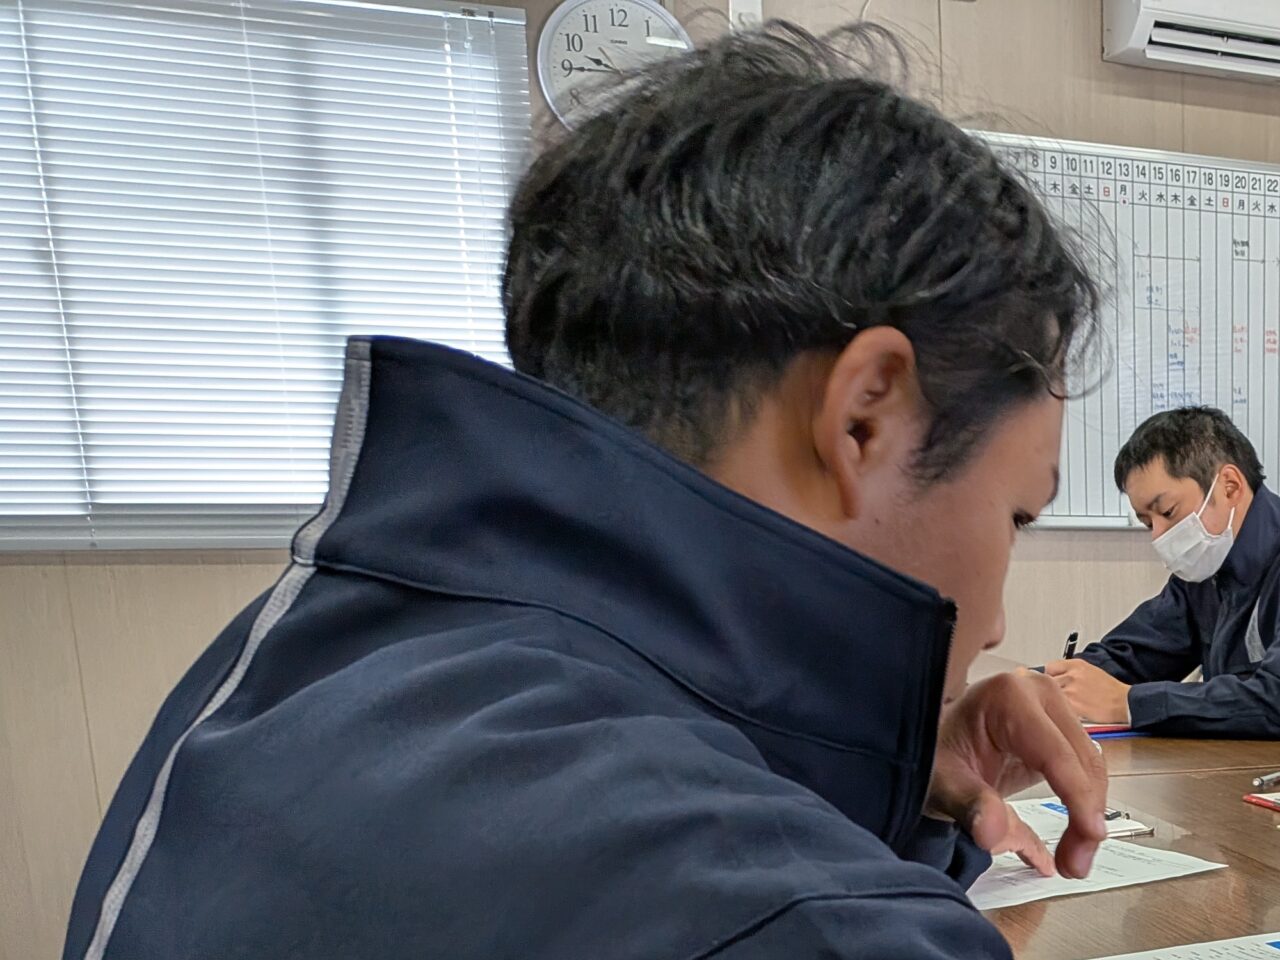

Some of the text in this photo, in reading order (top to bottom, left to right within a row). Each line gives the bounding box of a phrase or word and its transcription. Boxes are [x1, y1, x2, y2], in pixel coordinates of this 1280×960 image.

[583, 13, 599, 33] 11
[609, 8, 629, 28] 12
[644, 19, 651, 37] 1
[565, 33, 583, 52] 10
[561, 59, 573, 78] 9
[1031, 153, 1040, 168] 8
[1050, 156, 1057, 169] 9
[1065, 157, 1077, 172] 10
[1083, 159, 1094, 173] 11
[1101, 160, 1113, 176] 12
[1118, 163, 1130, 177] 13
[1136, 165, 1147, 179] 14
[1153, 166, 1164, 181] 15
[1170, 168, 1181, 183] 16
[1186, 170, 1197, 184] 17
[1203, 172, 1214, 186] 18
[1219, 173, 1230, 187] 19
[1235, 174, 1247, 190] 20
[1251, 177, 1262, 191] 21
[1267, 179, 1279, 193] 22
[1050, 181, 1061, 193] 木
[1069, 183, 1080, 195] 金
[1084, 184, 1094, 195] 土
[1103, 187, 1111, 197] 日
[1120, 185, 1128, 196] 月
[1139, 190, 1148, 201] 火
[1156, 192, 1166, 203] 水
[1171, 193, 1181, 204] 木
[1187, 195, 1197, 206] 金
[1205, 196, 1214, 206] 土
[1223, 197, 1230, 207] 日
[1238, 199, 1245, 211] 月
[1252, 201, 1262, 212] 火
[1267, 202, 1277, 213] 水
